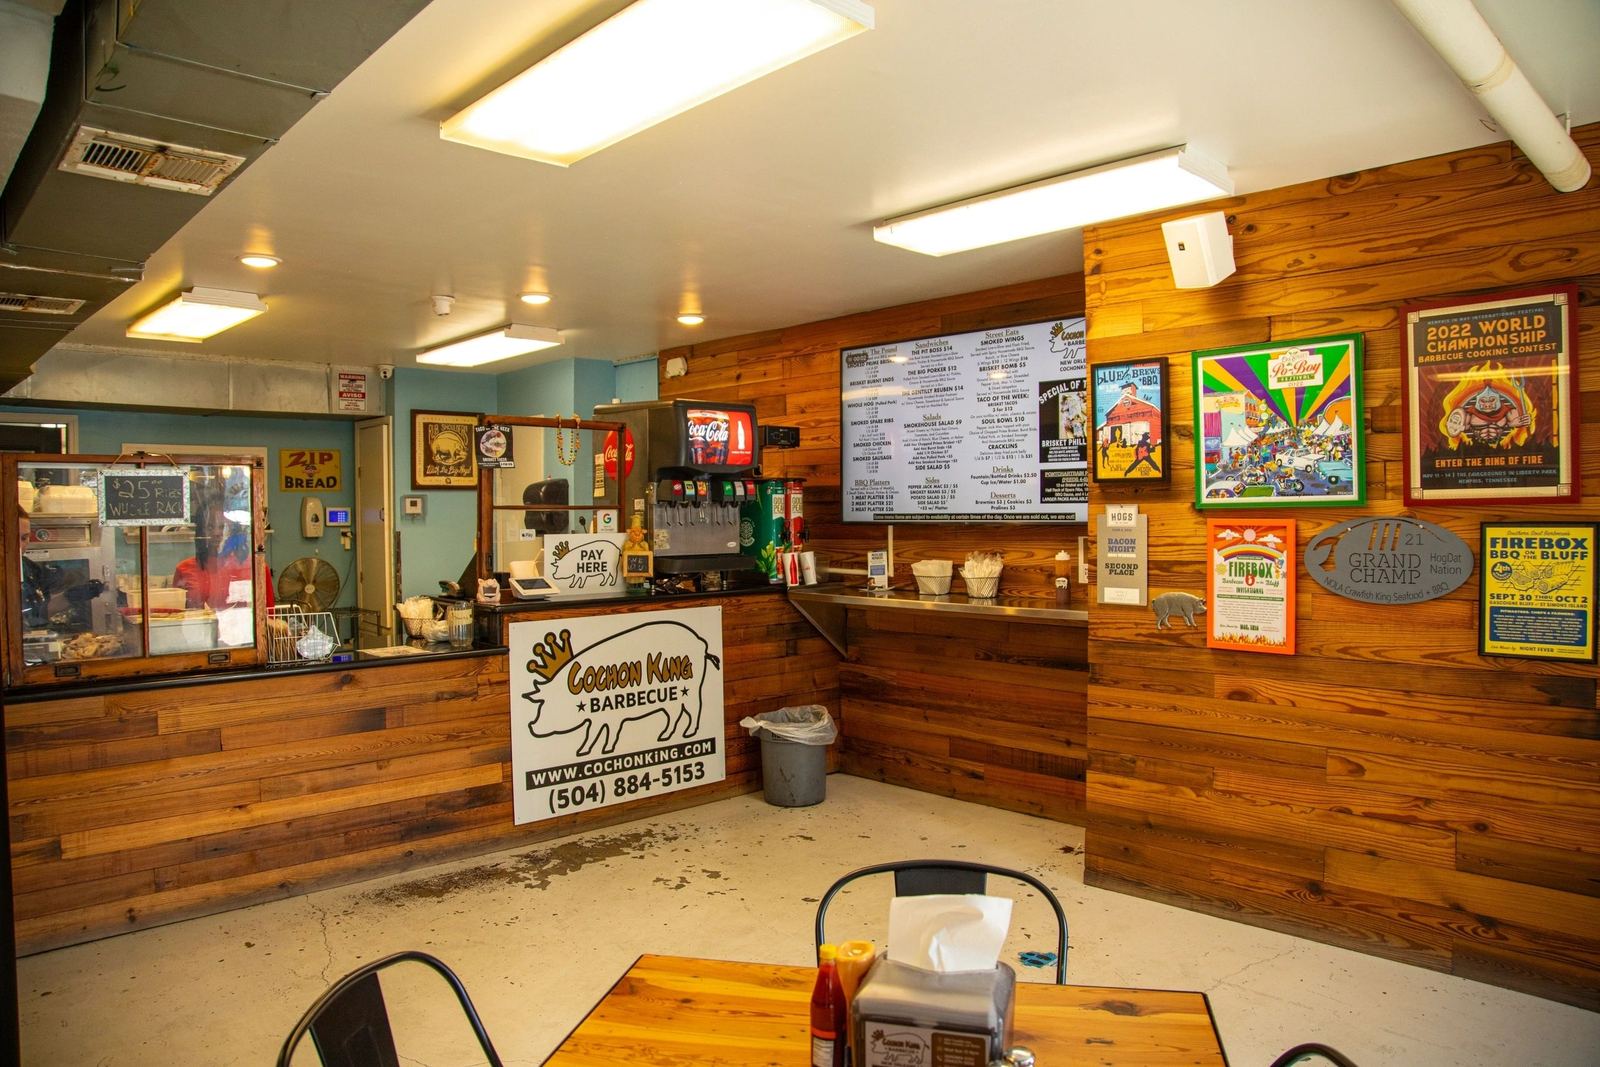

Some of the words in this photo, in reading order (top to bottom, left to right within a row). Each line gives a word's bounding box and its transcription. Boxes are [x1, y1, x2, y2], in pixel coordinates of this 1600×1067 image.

[1427, 323, 1472, 341] 2022
[1478, 315, 1546, 334] WORLD
[915, 339, 949, 349] Sandwiches
[1426, 330, 1547, 353] CHAMPIONSHIP
[1418, 352, 1464, 364] BARBECUE
[1466, 346, 1509, 358] COOKING
[1512, 343, 1557, 354] CONTEST
[1272, 360, 1321, 378] Po-Boy
[1040, 382, 1069, 404] SPECIAL
[1070, 380, 1080, 389] OF
[288, 452, 333, 467] ZIP
[1435, 459, 1462, 468] ENTER
[1465, 458, 1482, 467] THE
[1485, 457, 1505, 466] RING
[1508, 456, 1520, 465] OF
[1523, 455, 1543, 464] FIRE
[285, 476, 337, 488] BREAD
[1112, 513, 1133, 521] HOGS
[1405, 533, 1424, 546] 21
[1490, 537, 1588, 550] FIREBOX
[581, 550, 604, 560] PAY
[1349, 552, 1422, 568] GRAND
[1430, 552, 1462, 564] HogDat
[1490, 550, 1520, 560] BBQ
[1540, 551, 1588, 560] BLUFF
[577, 562, 607, 573] HERE
[1228, 562, 1272, 578] FIREBOX
[1430, 564, 1462, 575] Nation
[1350, 568, 1421, 584] CHAMP
[1324, 577, 1343, 592] NOLA
[1344, 586, 1374, 599] Crawfish
[1375, 592, 1392, 603] King
[1394, 590, 1424, 600] Seafood
[1432, 582, 1449, 594] BBQ
[590, 686, 678, 713] BARBECUE
[550, 779, 606, 814] (504)
[614, 761, 705, 797] 884-5153
